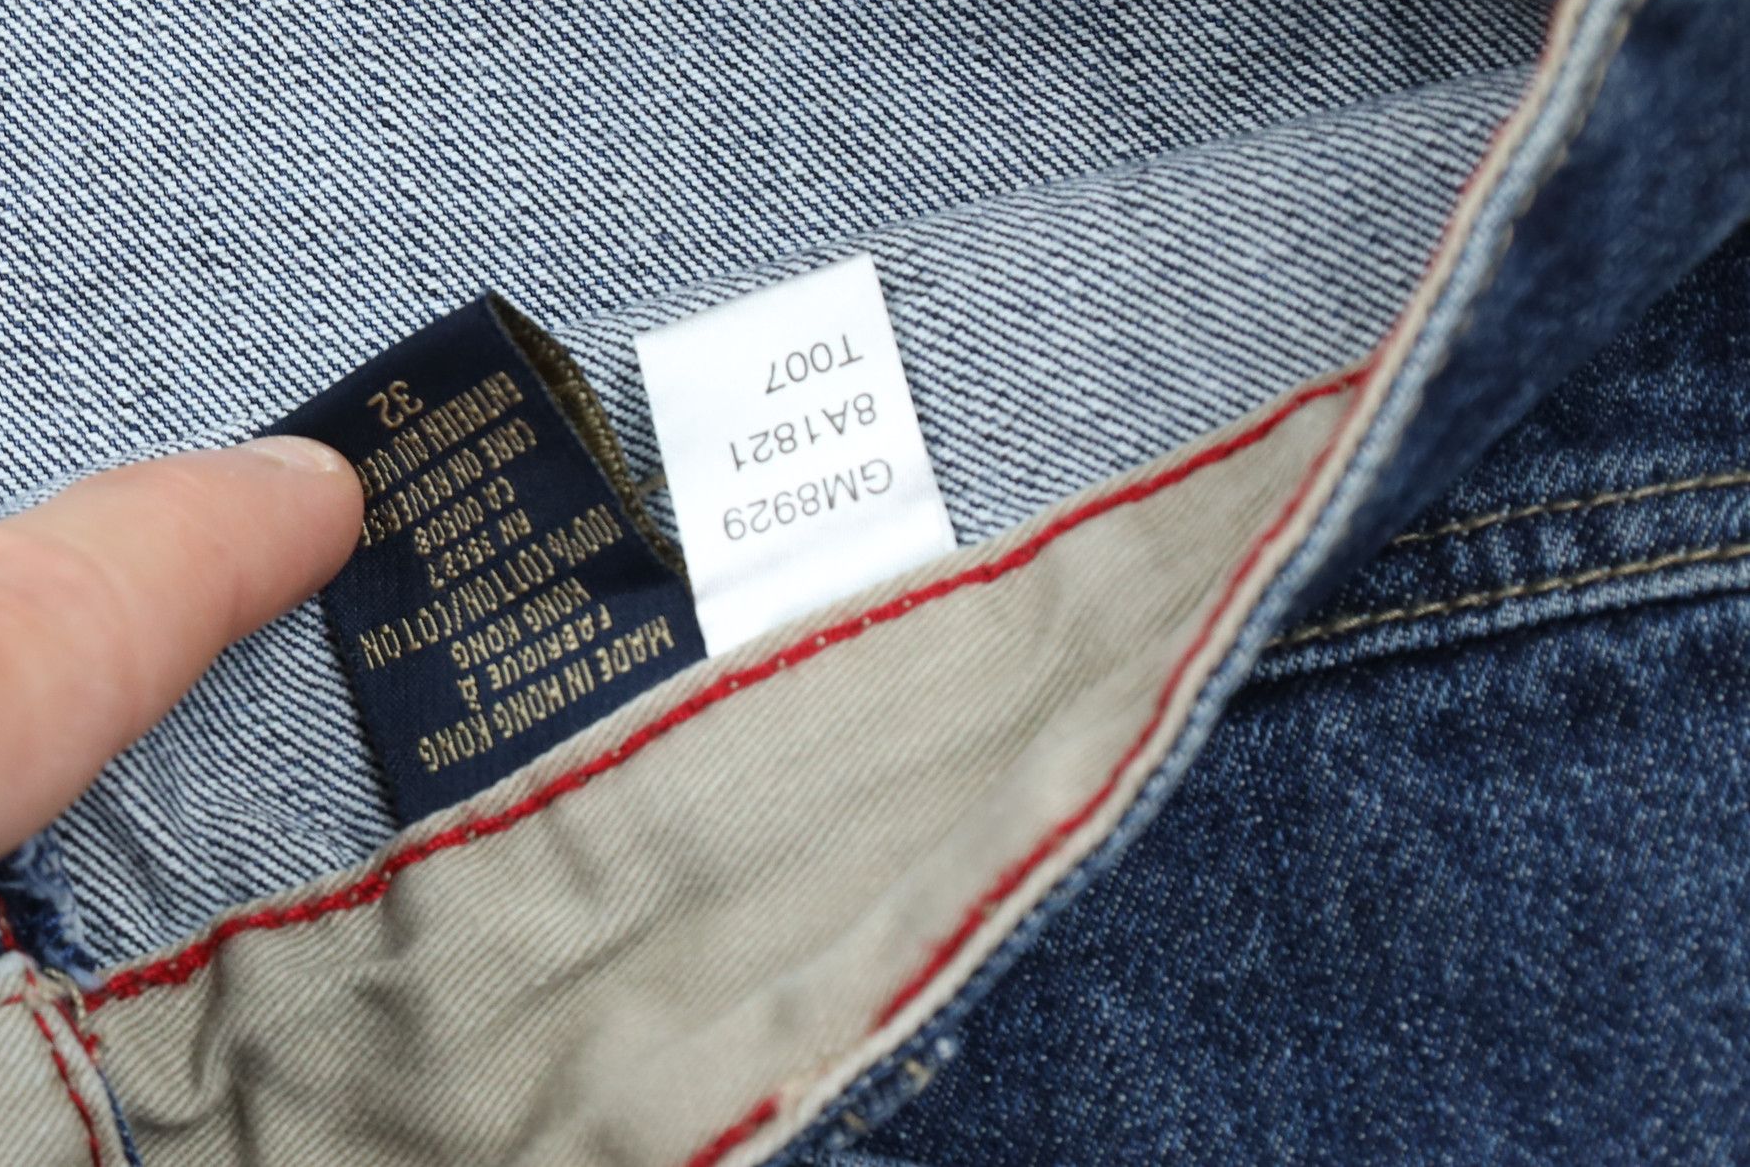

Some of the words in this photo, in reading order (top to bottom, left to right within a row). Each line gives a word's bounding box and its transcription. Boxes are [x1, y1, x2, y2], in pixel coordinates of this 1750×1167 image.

[765, 334, 864, 394] T007
[366, 380, 424, 429] 32
[730, 393, 877, 472] 8A1821
[392, 427, 429, 472] AU
[448, 448, 483, 490] ON
[478, 417, 537, 469] CARE
[481, 476, 515, 511] CA
[723, 458, 893, 540] GM8929
[499, 508, 532, 546] RN
[546, 503, 623, 566] 100%
[359, 543, 555, 670] COTTON/COTON
[521, 576, 591, 632] HONG
[451, 614, 521, 670] KONG
[486, 603, 613, 691] FABRIQUE
[596, 615, 675, 682] MADE
[492, 674, 566, 738] HONG
[564, 658, 595, 702] IN
[417, 713, 493, 773] KONG
